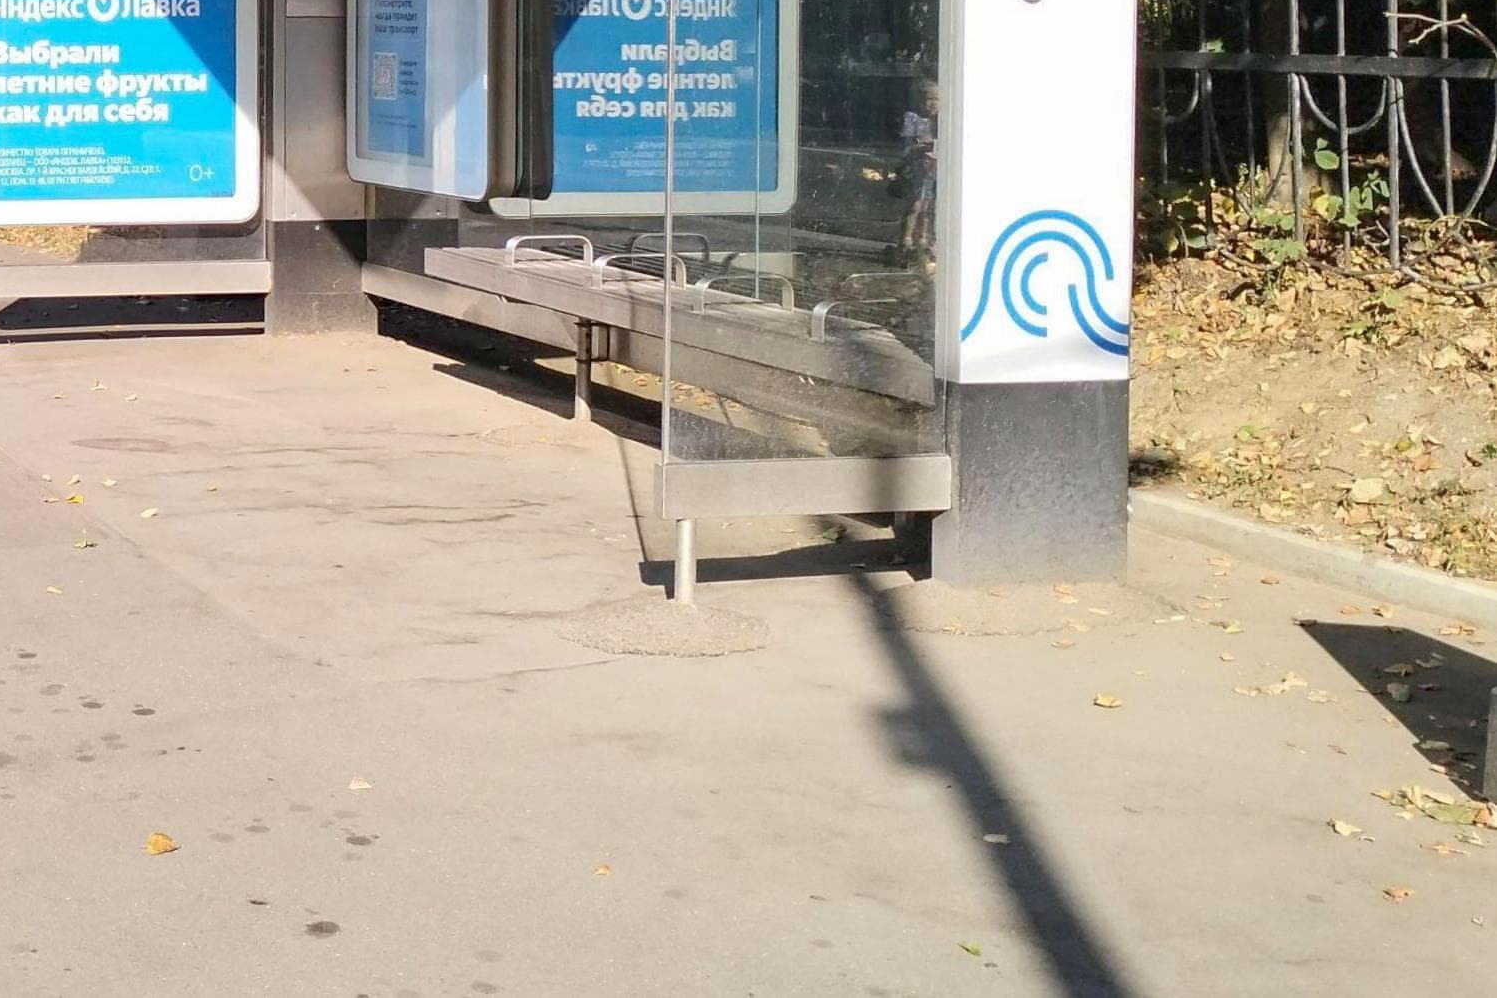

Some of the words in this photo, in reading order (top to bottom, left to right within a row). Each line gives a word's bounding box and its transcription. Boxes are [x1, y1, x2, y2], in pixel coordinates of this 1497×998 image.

[96, 69, 207, 97] фрукты
[44, 104, 99, 127] для
[104, 98, 169, 122] себя
[189, 164, 215, 182] 0+
